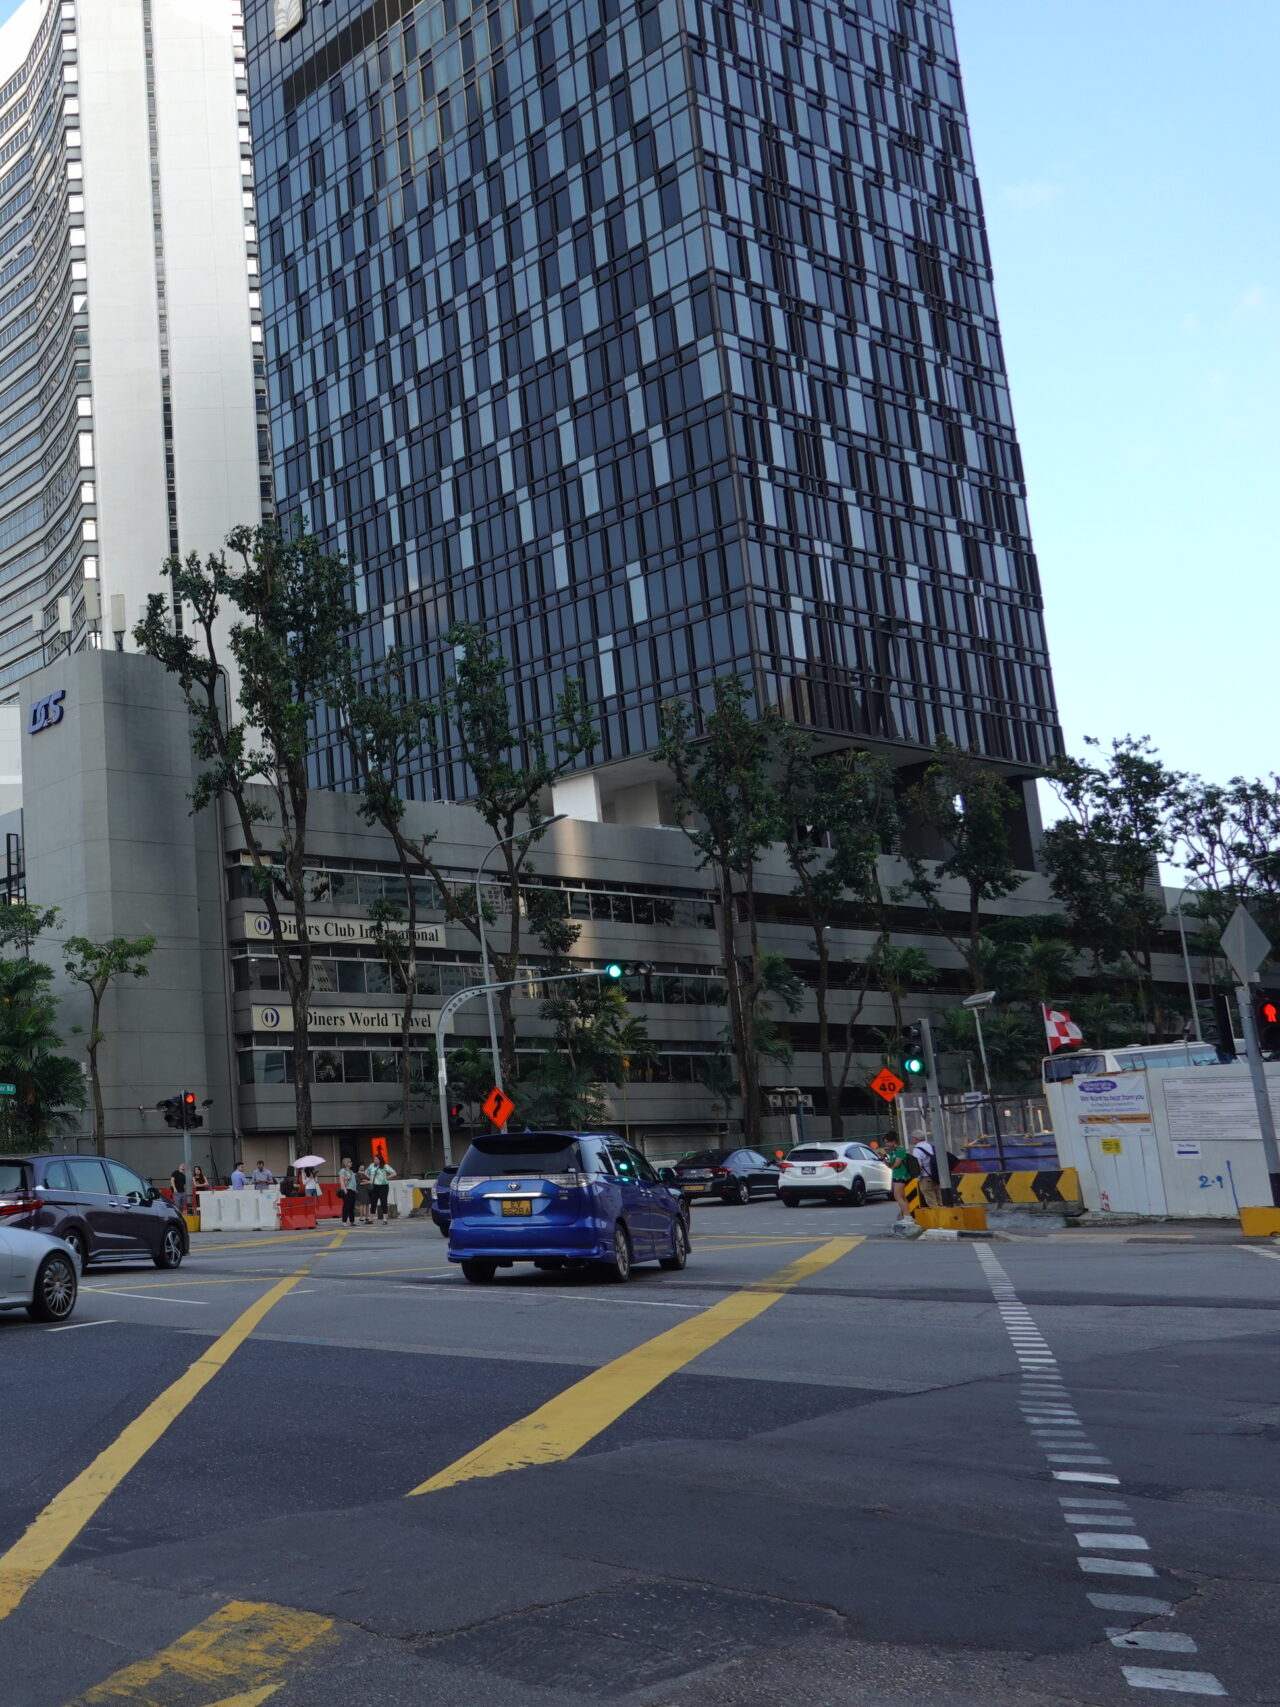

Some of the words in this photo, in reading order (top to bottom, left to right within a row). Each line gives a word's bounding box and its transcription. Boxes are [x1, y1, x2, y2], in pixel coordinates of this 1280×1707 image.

[279, 920, 320, 936] Dinrs
[324, 921, 355, 938] Club
[359, 924, 439, 942] Intratonal
[306, 1011, 346, 1026] Diners
[349, 1012, 389, 1027] World
[392, 1013, 432, 1028] Tvel
[880, 1083, 896, 1092] 40
